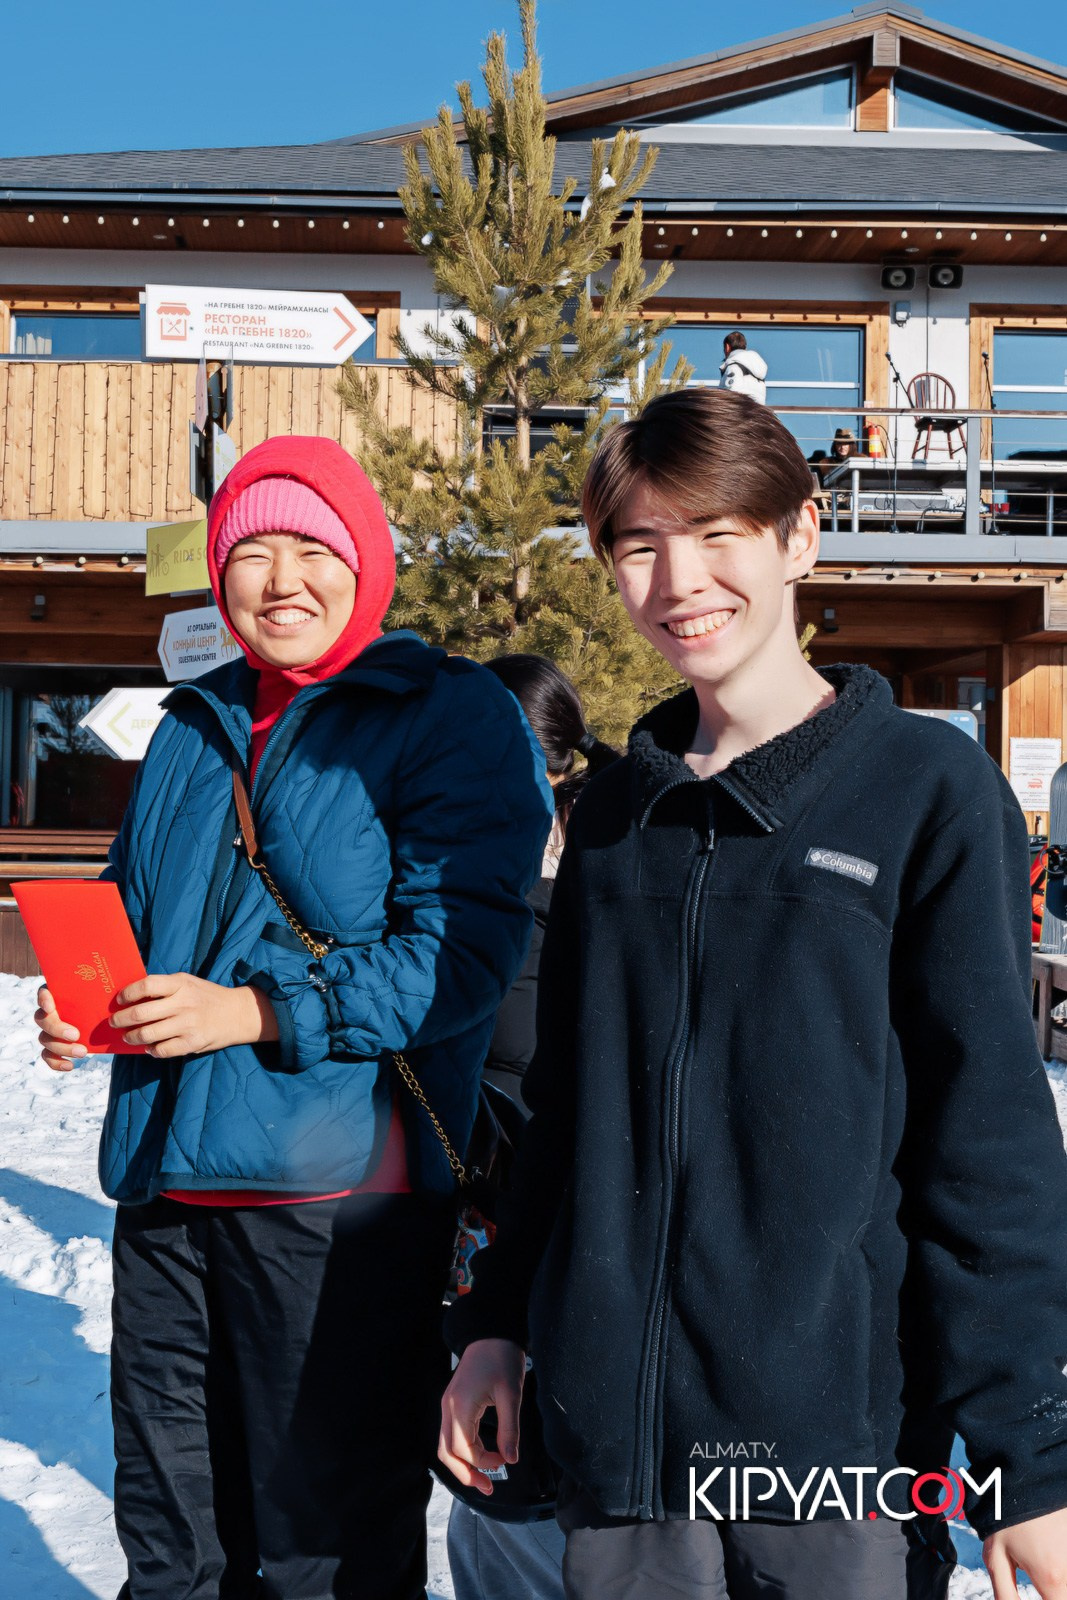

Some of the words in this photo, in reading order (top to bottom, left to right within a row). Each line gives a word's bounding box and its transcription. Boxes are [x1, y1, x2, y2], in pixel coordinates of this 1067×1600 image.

[268, 303, 329, 313] МЕЙРАМХАНАСЫ
[204, 313, 266, 325] РЕСТОРАН
[204, 325, 229, 335] «НА
[232, 326, 275, 337] ГРЕБНЕ
[278, 328, 313, 338] 1820»
[203, 339, 249, 347] RESTAURANT
[266, 342, 293, 350] GREBNE
[173, 548, 195, 564] RIDE
[197, 635, 217, 649] ЦЕНТР
[201, 652, 217, 662] CENTER
[821, 853, 873, 880] Columbia
